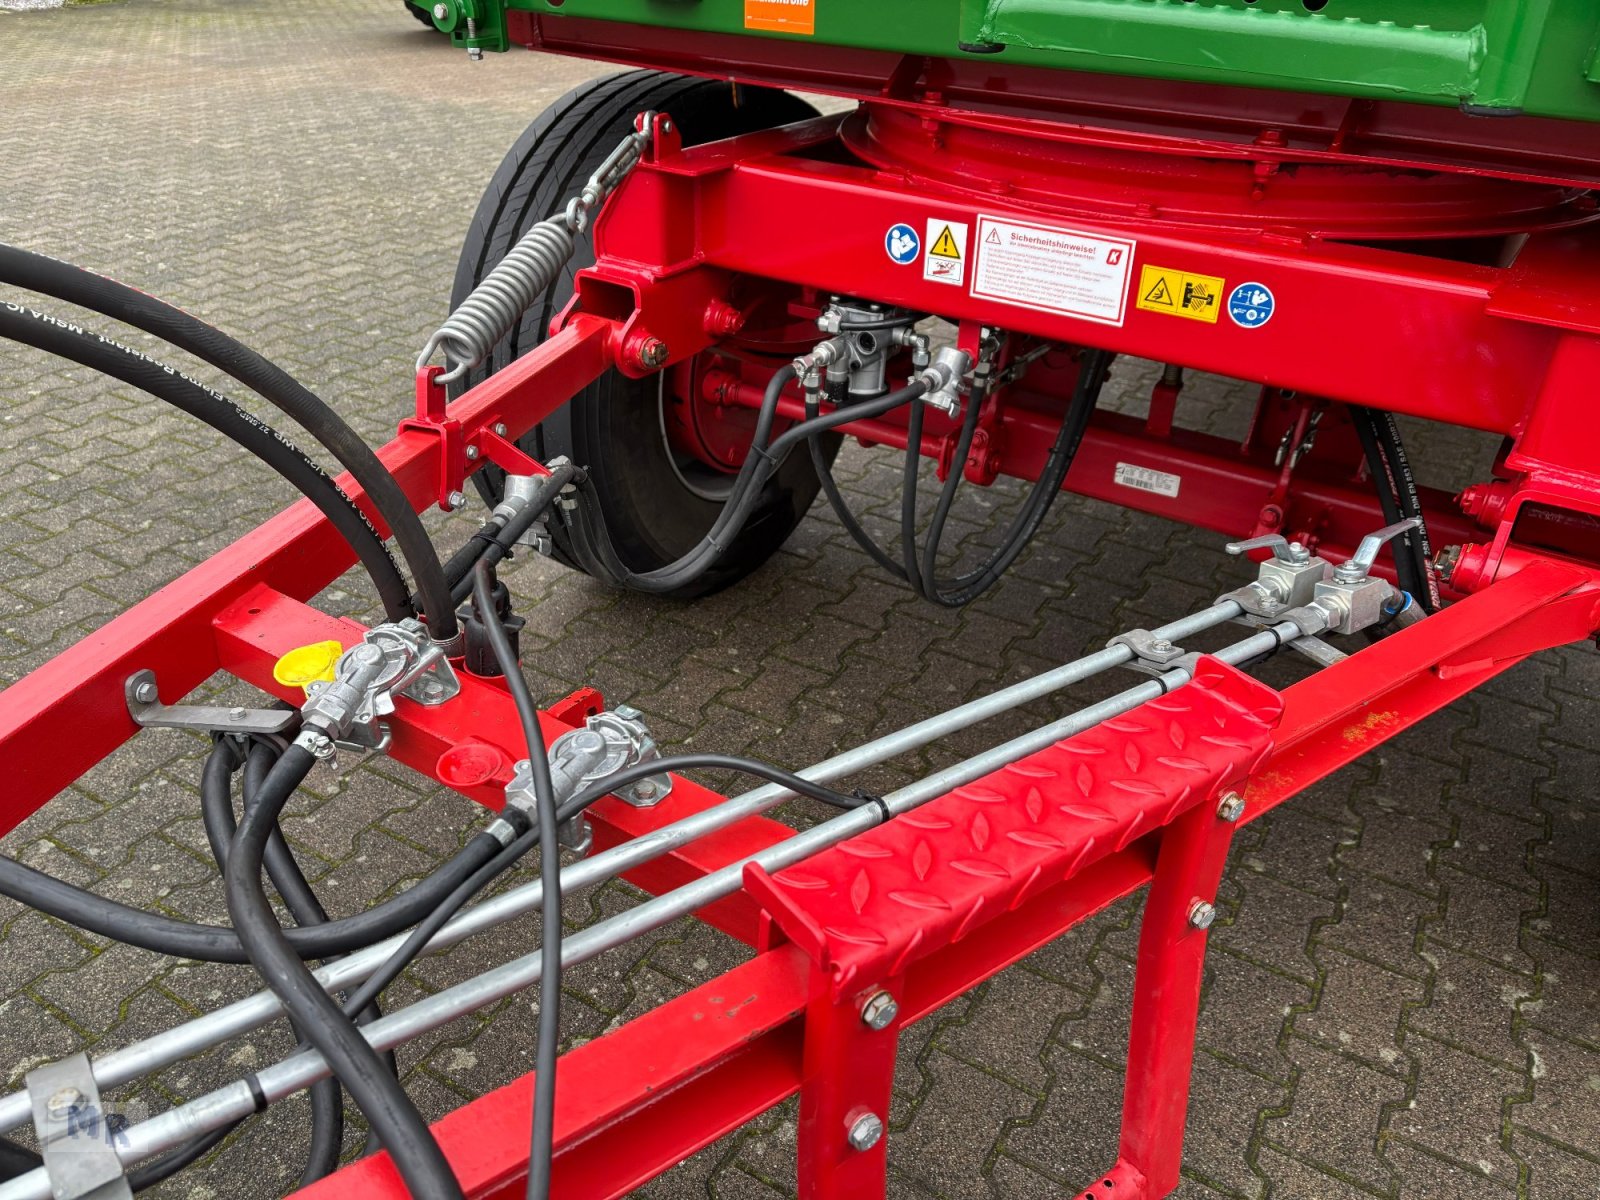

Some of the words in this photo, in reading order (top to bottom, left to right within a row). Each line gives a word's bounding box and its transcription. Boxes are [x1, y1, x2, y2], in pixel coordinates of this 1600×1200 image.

[1010, 232, 1097, 255] Sicherheitshinweise!
[30, 309, 83, 334] MSHA
[1396, 447, 1407, 463] SAE
[1408, 482, 1417, 495] EN
[1410, 495, 1421, 510] DIN
